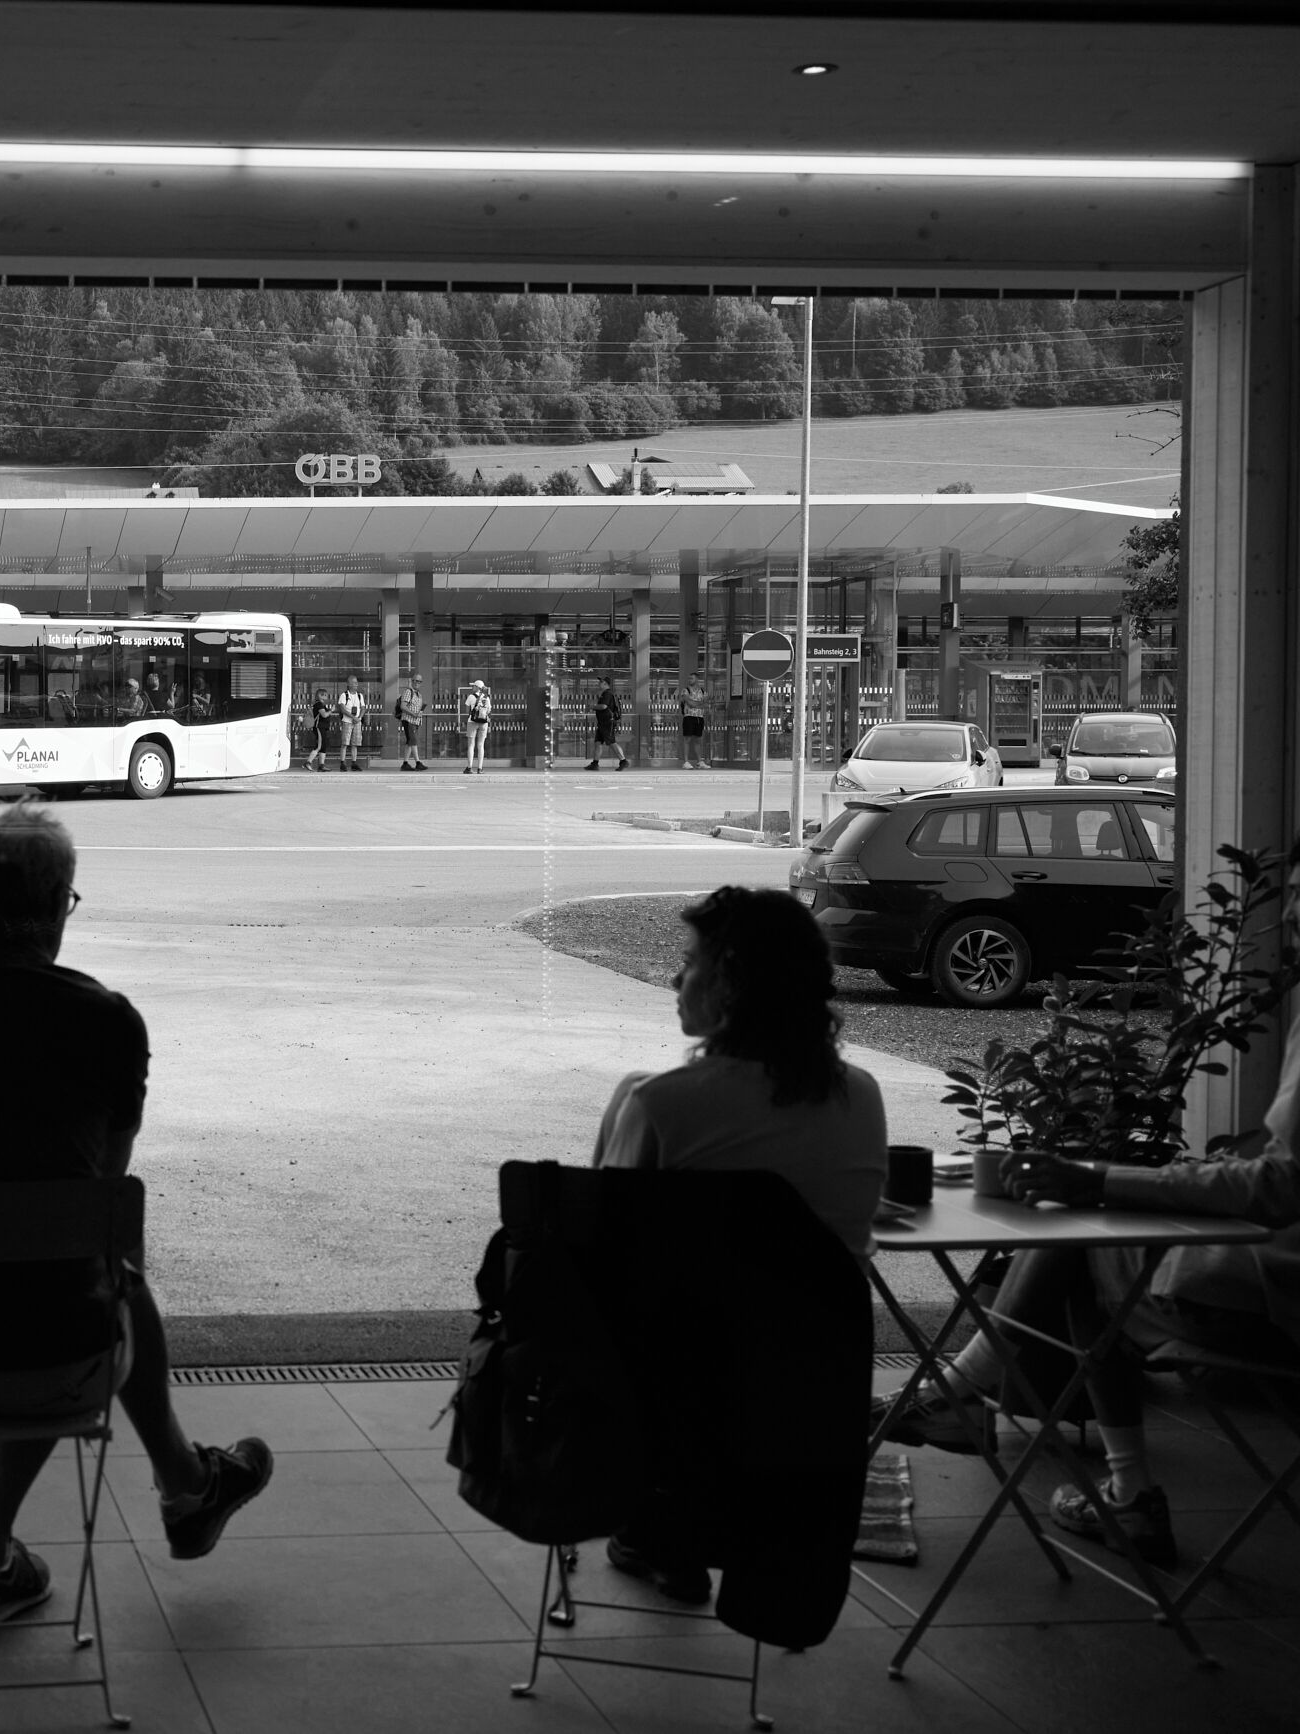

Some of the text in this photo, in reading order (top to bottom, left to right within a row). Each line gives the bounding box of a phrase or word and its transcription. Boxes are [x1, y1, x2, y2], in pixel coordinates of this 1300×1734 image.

[295, 453, 382, 484] ÖBB
[48, 634, 60, 644] Ich
[62, 634, 81, 645] fahre
[83, 635, 95, 645] mit
[96, 635, 112, 645] HVO
[120, 636, 133, 646] das
[134, 636, 152, 648] spart
[154, 637, 171, 646] 90%
[813, 648, 844, 656] Bahnsteig
[845, 648, 851, 656] 2,
[16, 750, 59, 762] PLANAI
